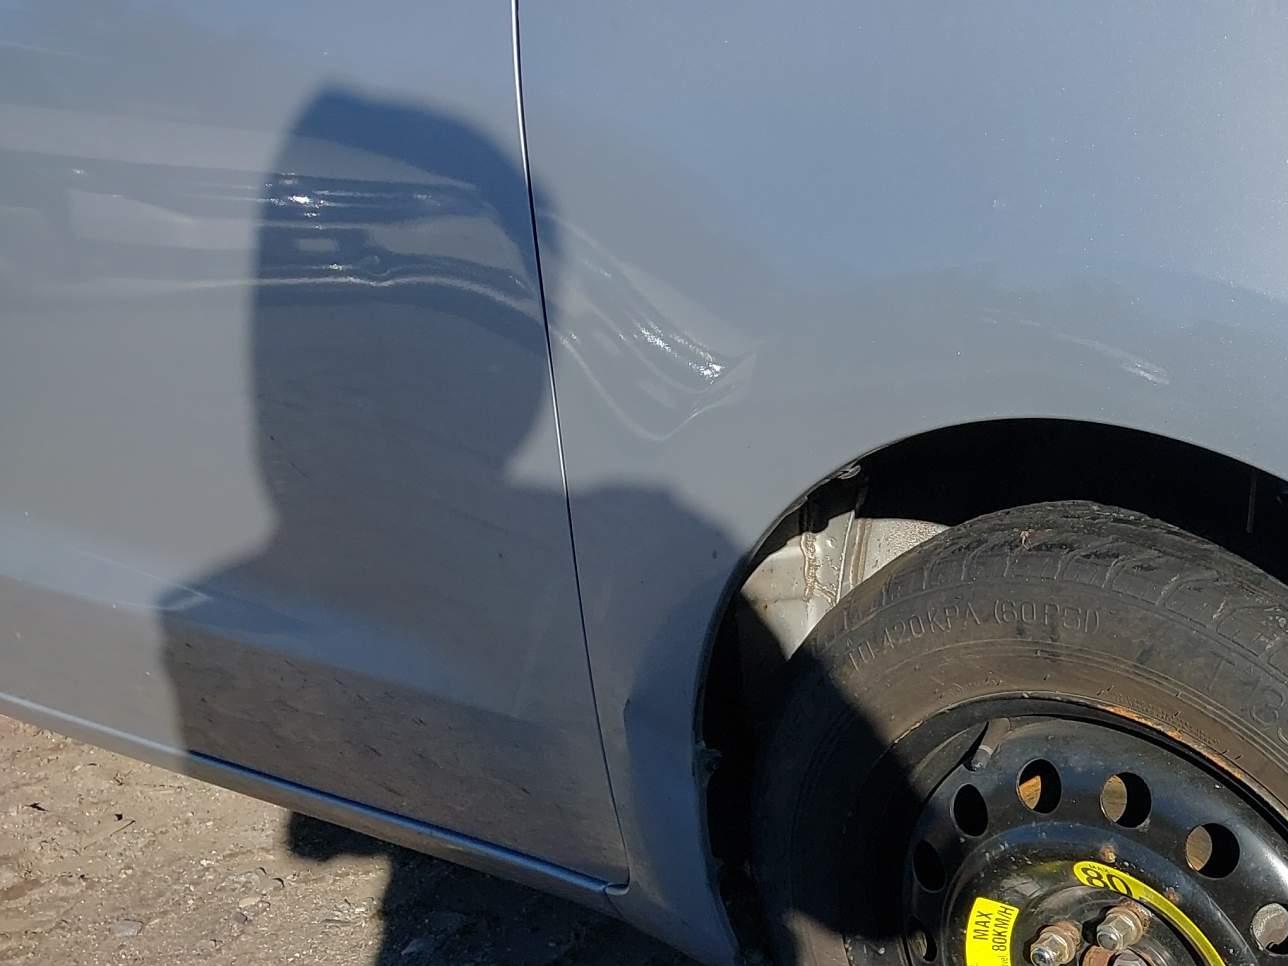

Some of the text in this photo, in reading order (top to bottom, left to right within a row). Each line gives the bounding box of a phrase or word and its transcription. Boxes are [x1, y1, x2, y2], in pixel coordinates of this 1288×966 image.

[1081, 868, 1134, 897] 80
[973, 911, 992, 940] MAX
[992, 905, 1015, 952] 80KM/H
